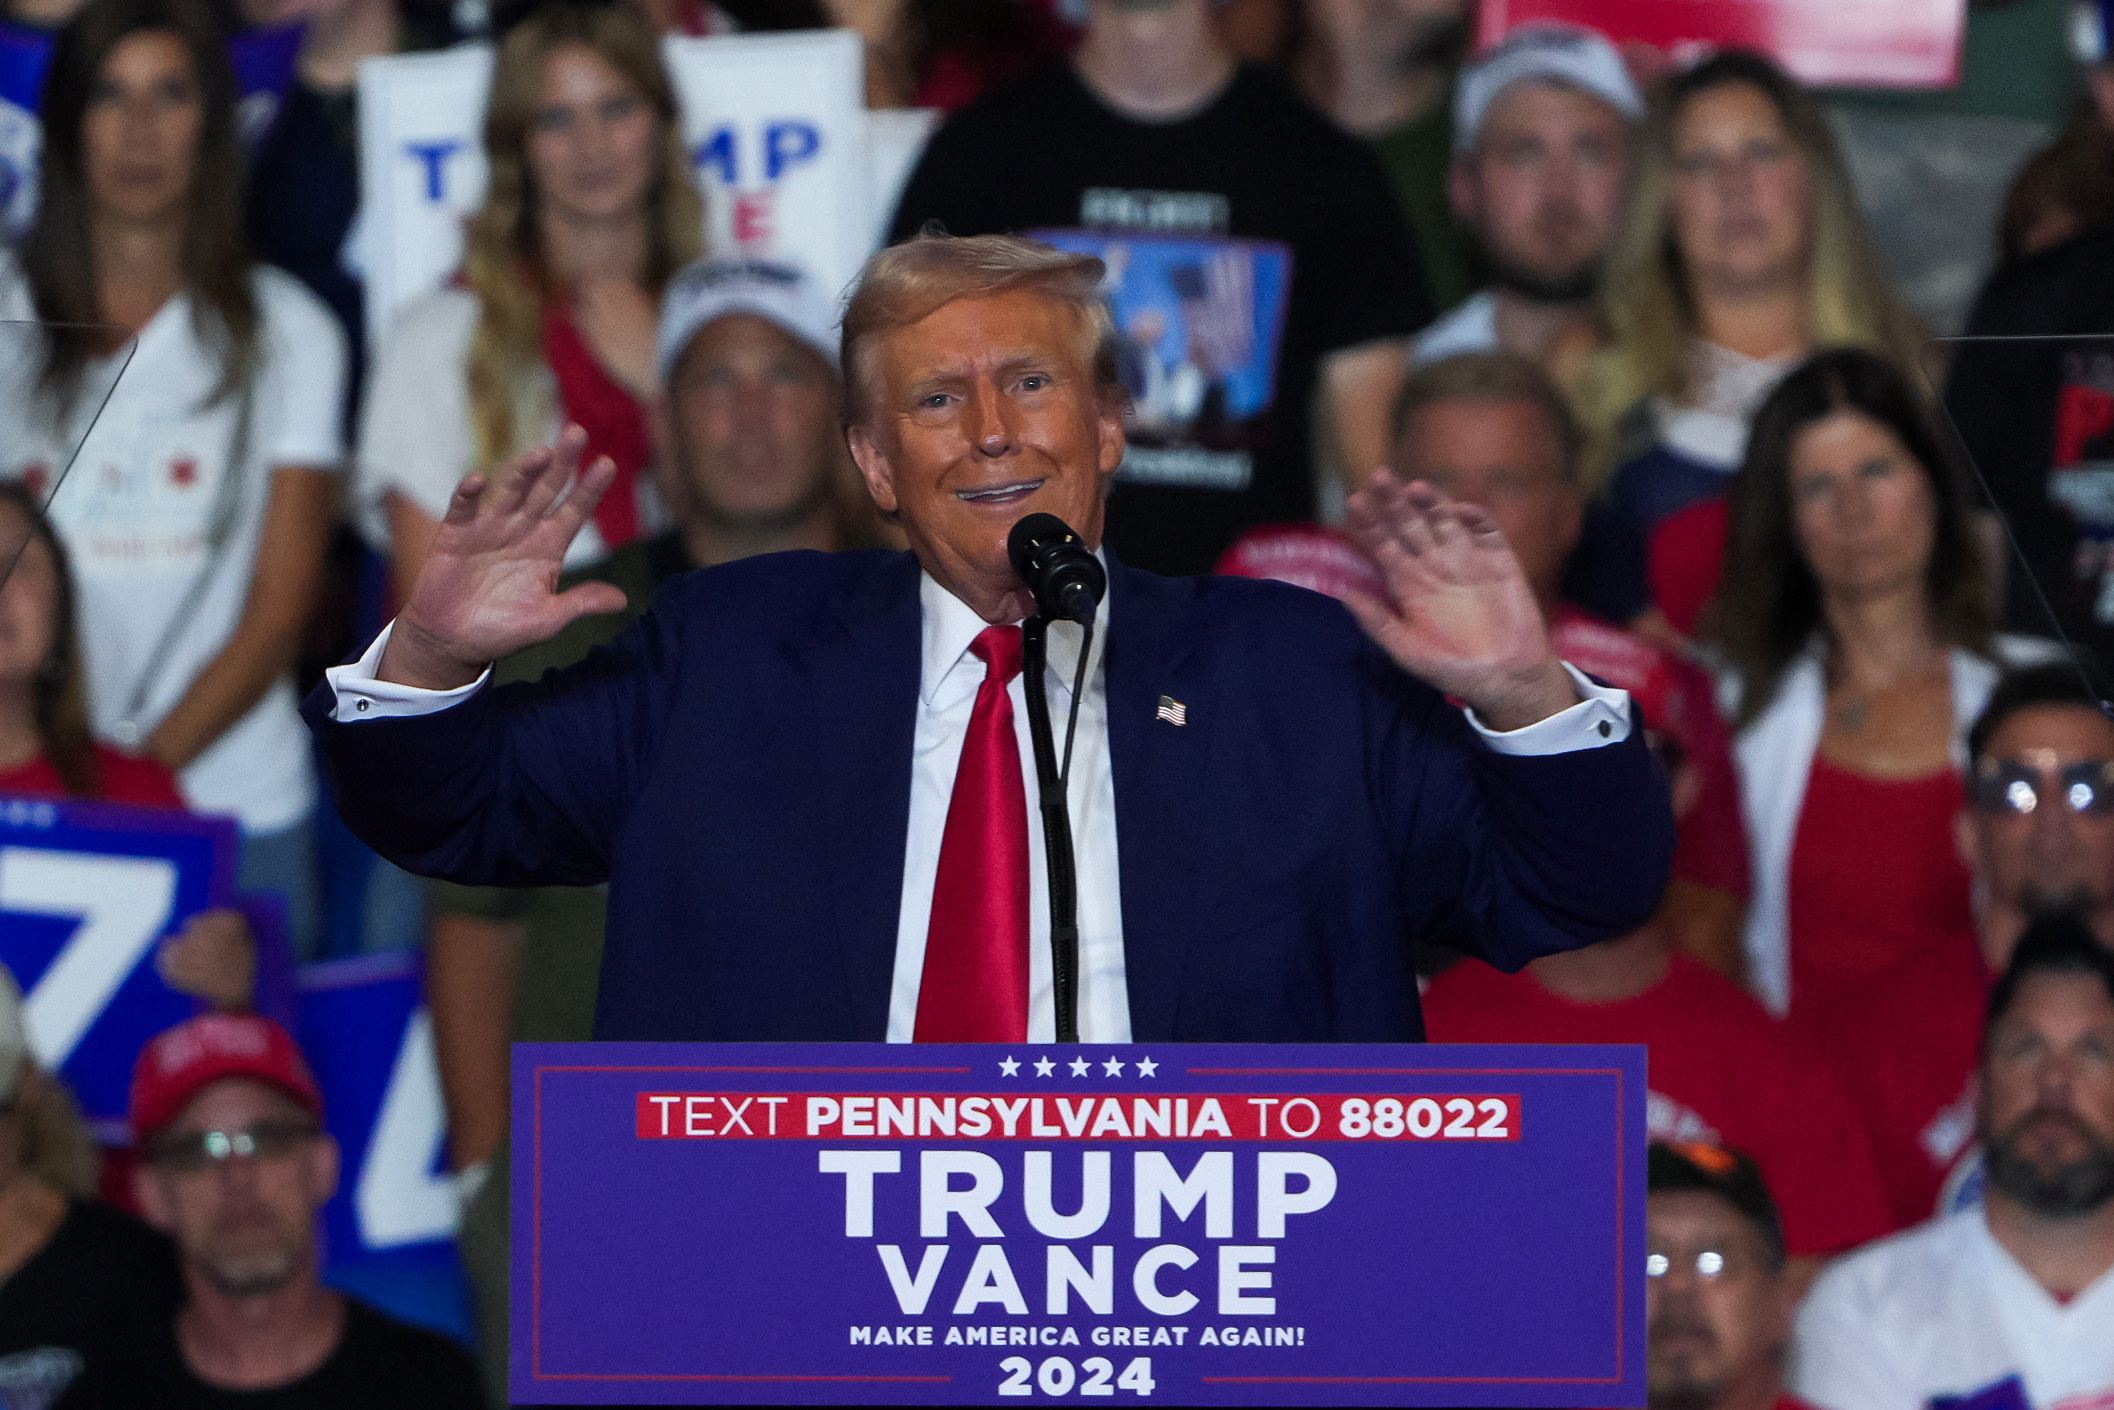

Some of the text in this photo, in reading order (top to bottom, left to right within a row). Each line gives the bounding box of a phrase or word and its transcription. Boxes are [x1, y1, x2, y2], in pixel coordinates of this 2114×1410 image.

[649, 1096, 1509, 1139] TEXT PENNSYLVANIA TO 88022
[818, 1150, 1339, 1240] TRUMP
[876, 1243, 1277, 1316] VANCE
[850, 1326, 1306, 1347] MAKE AMERICA GREAT AGAIN!
[998, 1356, 1157, 1397] 2024
